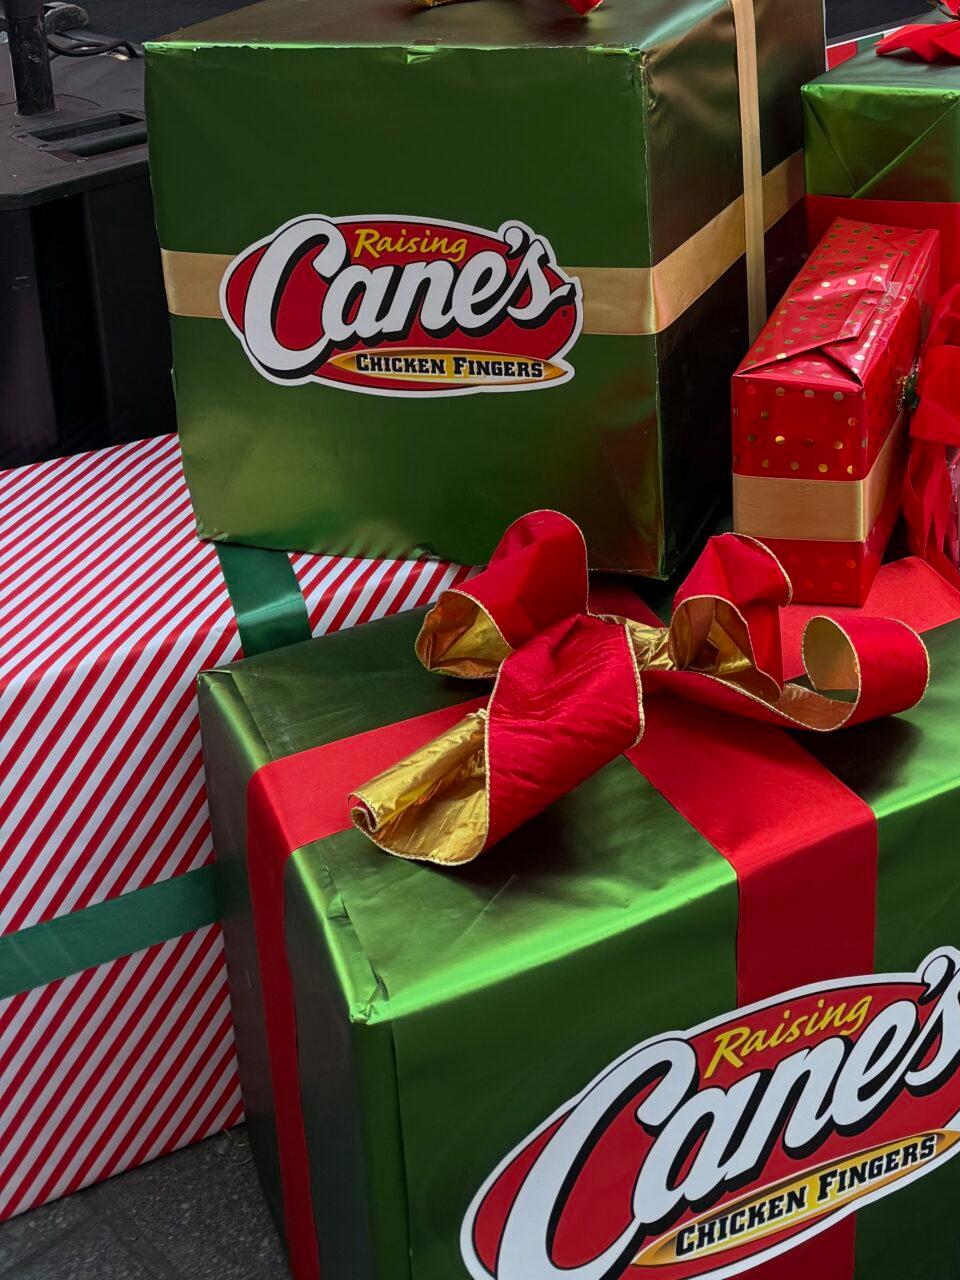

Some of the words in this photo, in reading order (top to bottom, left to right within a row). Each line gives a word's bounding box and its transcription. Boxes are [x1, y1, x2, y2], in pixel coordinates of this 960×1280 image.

[353, 228, 468, 263] Raising
[243, 217, 577, 379] Cane's
[355, 352, 447, 376] CHICKEN
[452, 353, 544, 379] FINGERS
[703, 994, 873, 1079] Raising
[674, 1191, 807, 1258] CHICKEN
[816, 1134, 937, 1204] FINGERS
